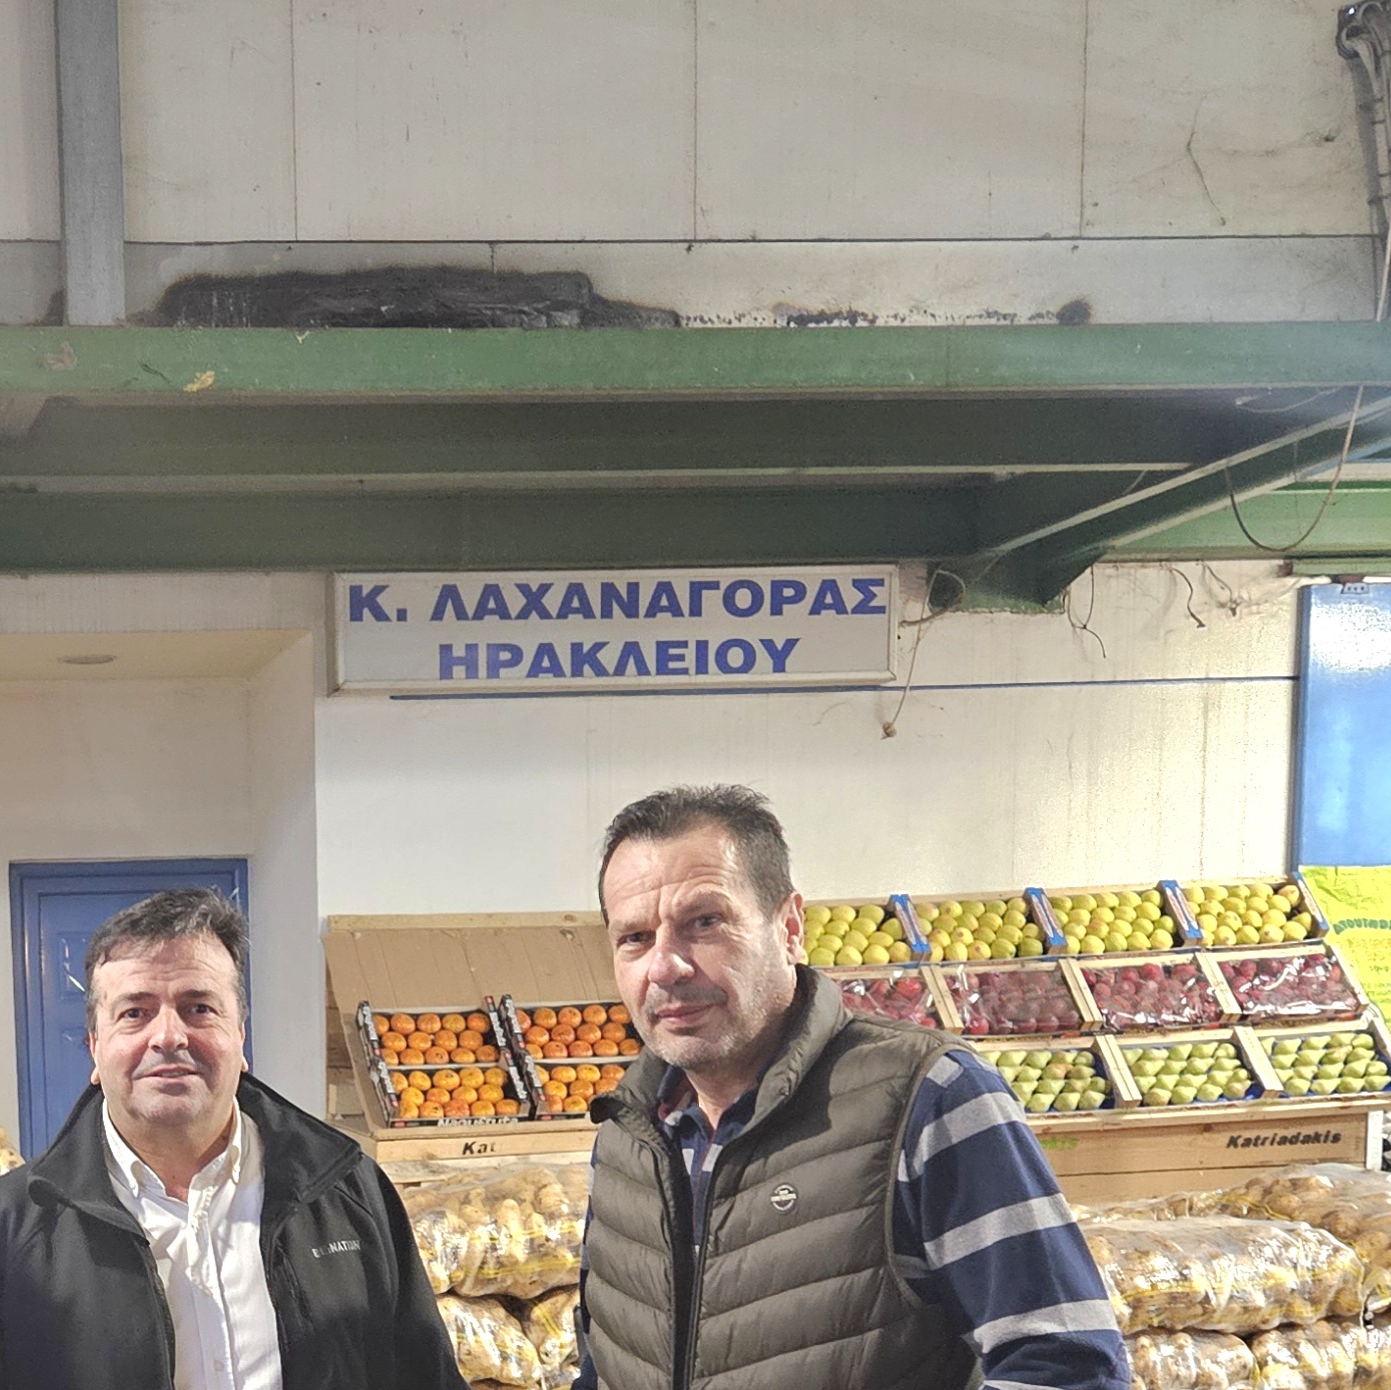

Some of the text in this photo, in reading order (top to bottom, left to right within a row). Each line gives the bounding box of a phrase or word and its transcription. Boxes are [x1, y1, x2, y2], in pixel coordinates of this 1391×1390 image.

[348, 577, 887, 623] Κ. ΛΑΧΑΝΑΓΟΡΑΣ
[438, 637, 802, 681] ΗΡΑΚΛΕΙΟΥ
[1226, 1130, 1342, 1149] Katriadakis
